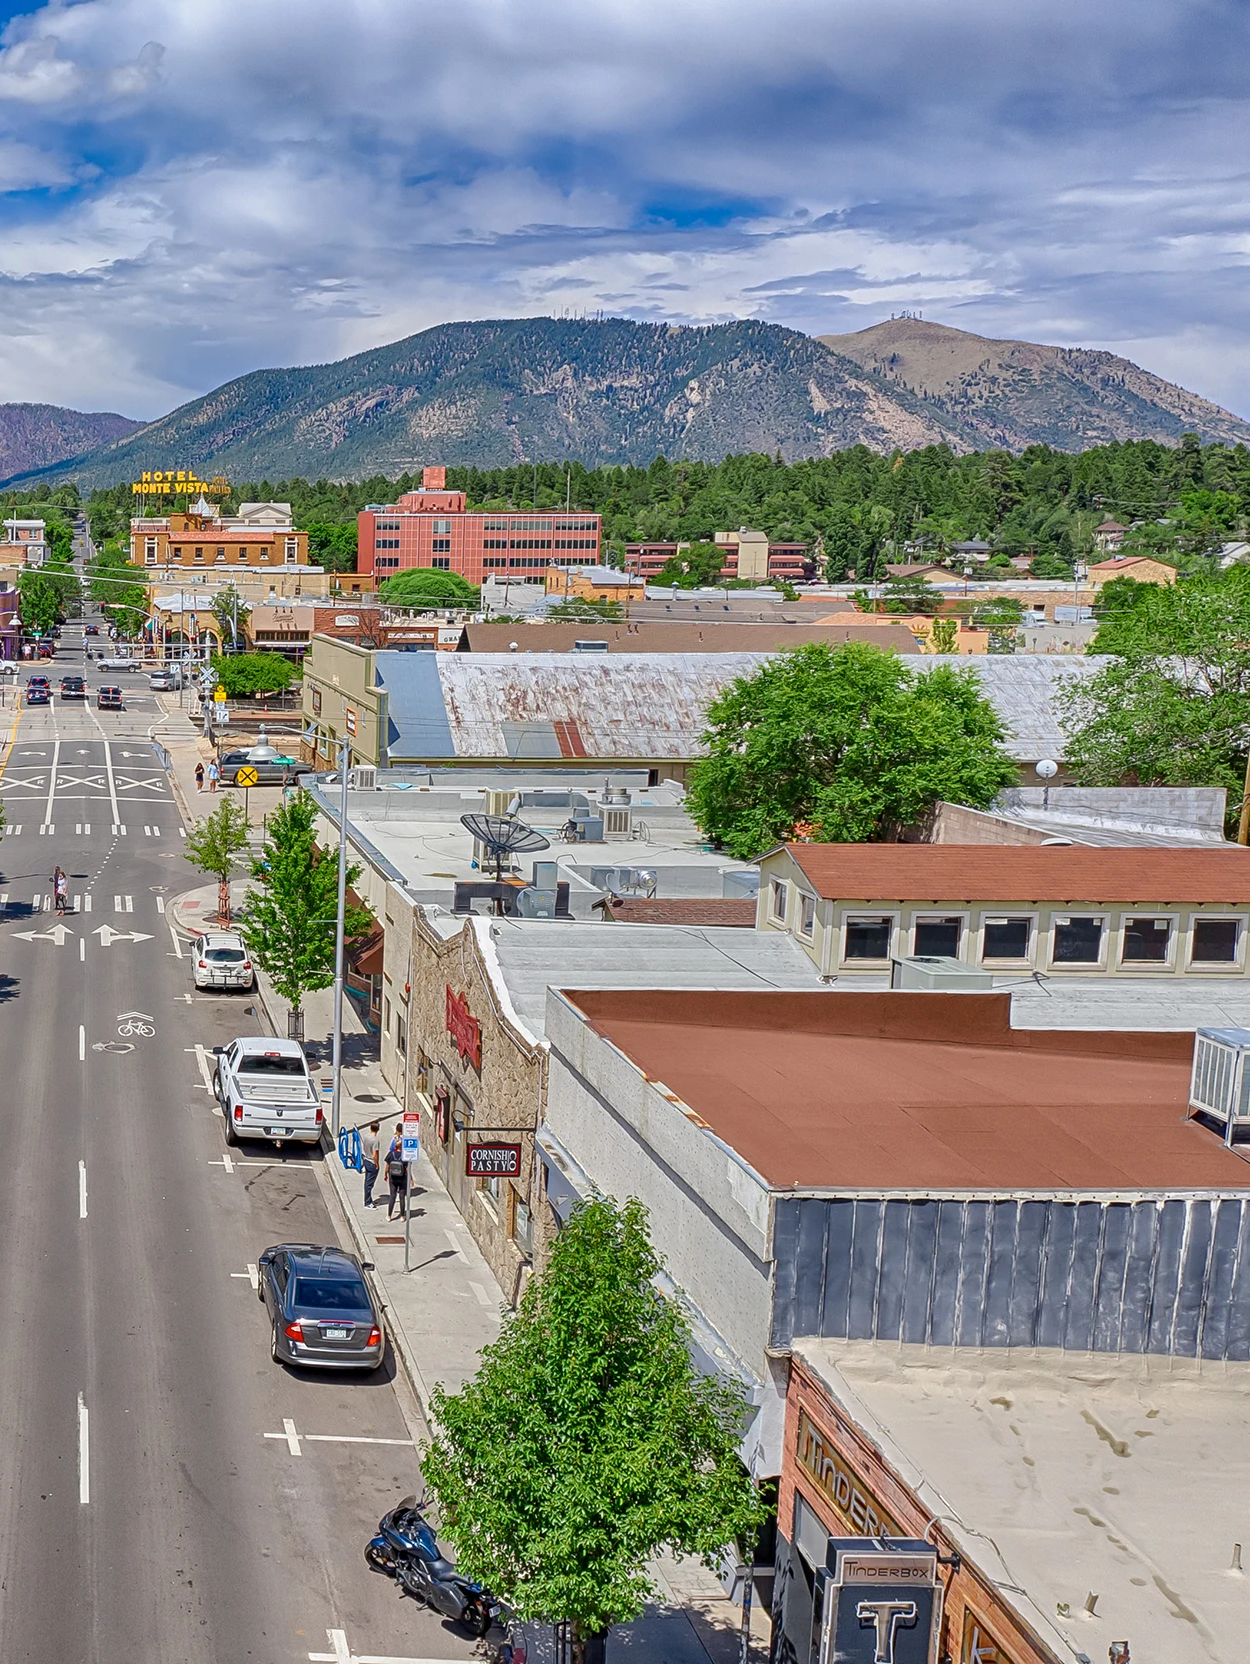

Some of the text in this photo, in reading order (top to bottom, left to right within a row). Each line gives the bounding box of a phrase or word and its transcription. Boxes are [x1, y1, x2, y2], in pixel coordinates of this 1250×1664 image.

[142, 471, 198, 482] HOTEL
[133, 483, 171, 494] MONTE
[175, 482, 209, 493] VISTA
[444, 635, 461, 643] GRA
[471, 1150, 508, 1161] CORNISH
[471, 1161, 508, 1171] PASTY
[856, 1602, 918, 1664] T
